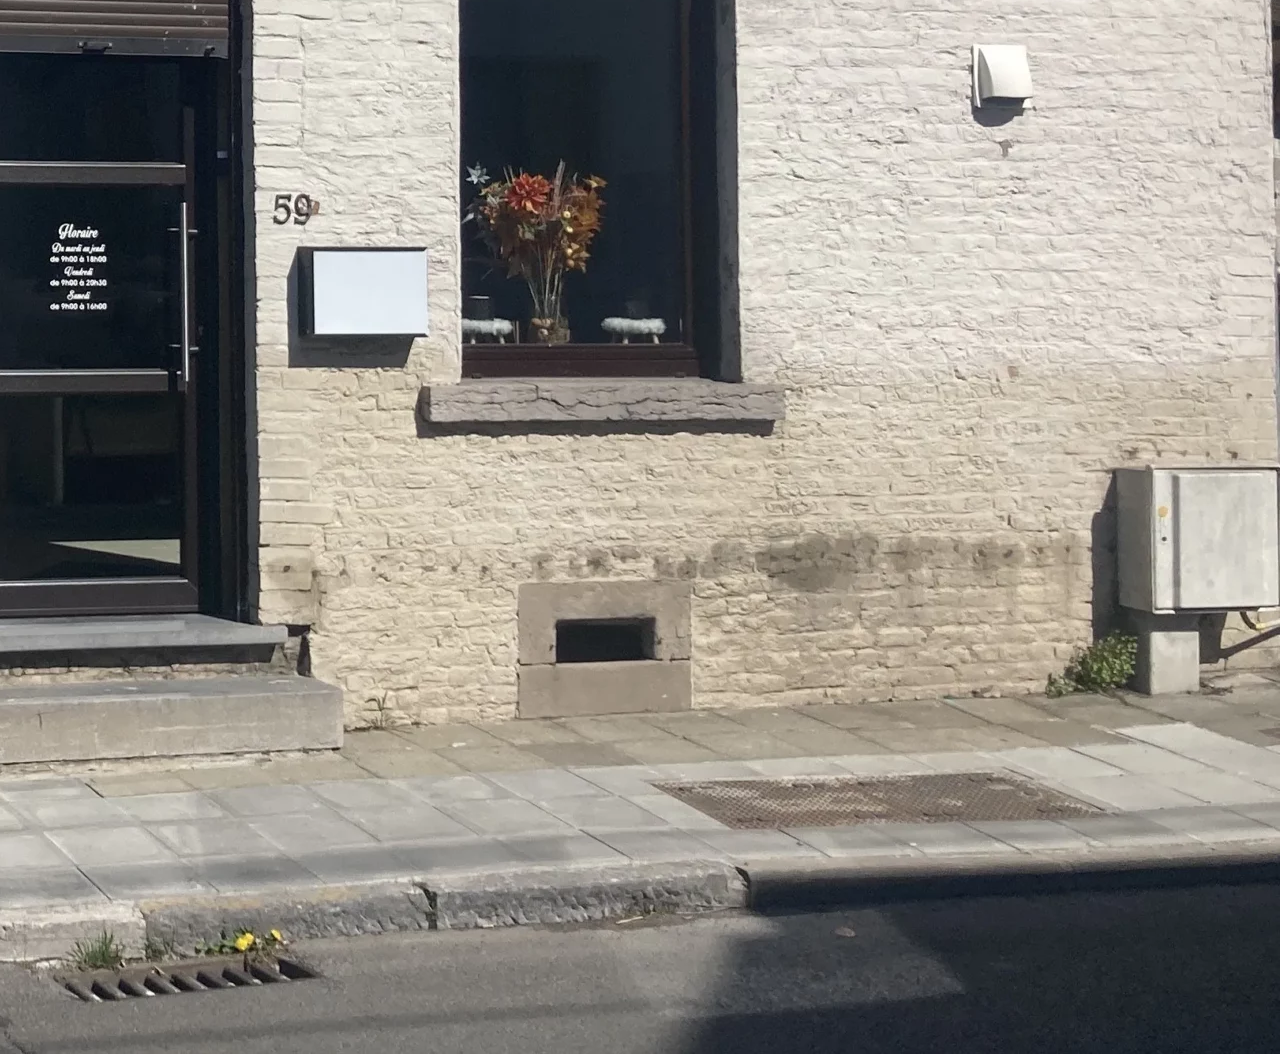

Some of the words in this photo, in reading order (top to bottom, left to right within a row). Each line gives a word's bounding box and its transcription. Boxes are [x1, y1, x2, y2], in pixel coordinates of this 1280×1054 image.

[273, 194, 312, 225] 59
[58, 223, 99, 240] Horaire
[60, 255, 78, 263] 9h00
[64, 266, 94, 277] Vendredi
[60, 279, 78, 287] 9h00
[66, 290, 91, 301] Samedi
[49, 303, 60, 311] de
[60, 303, 78, 311] 9h00
